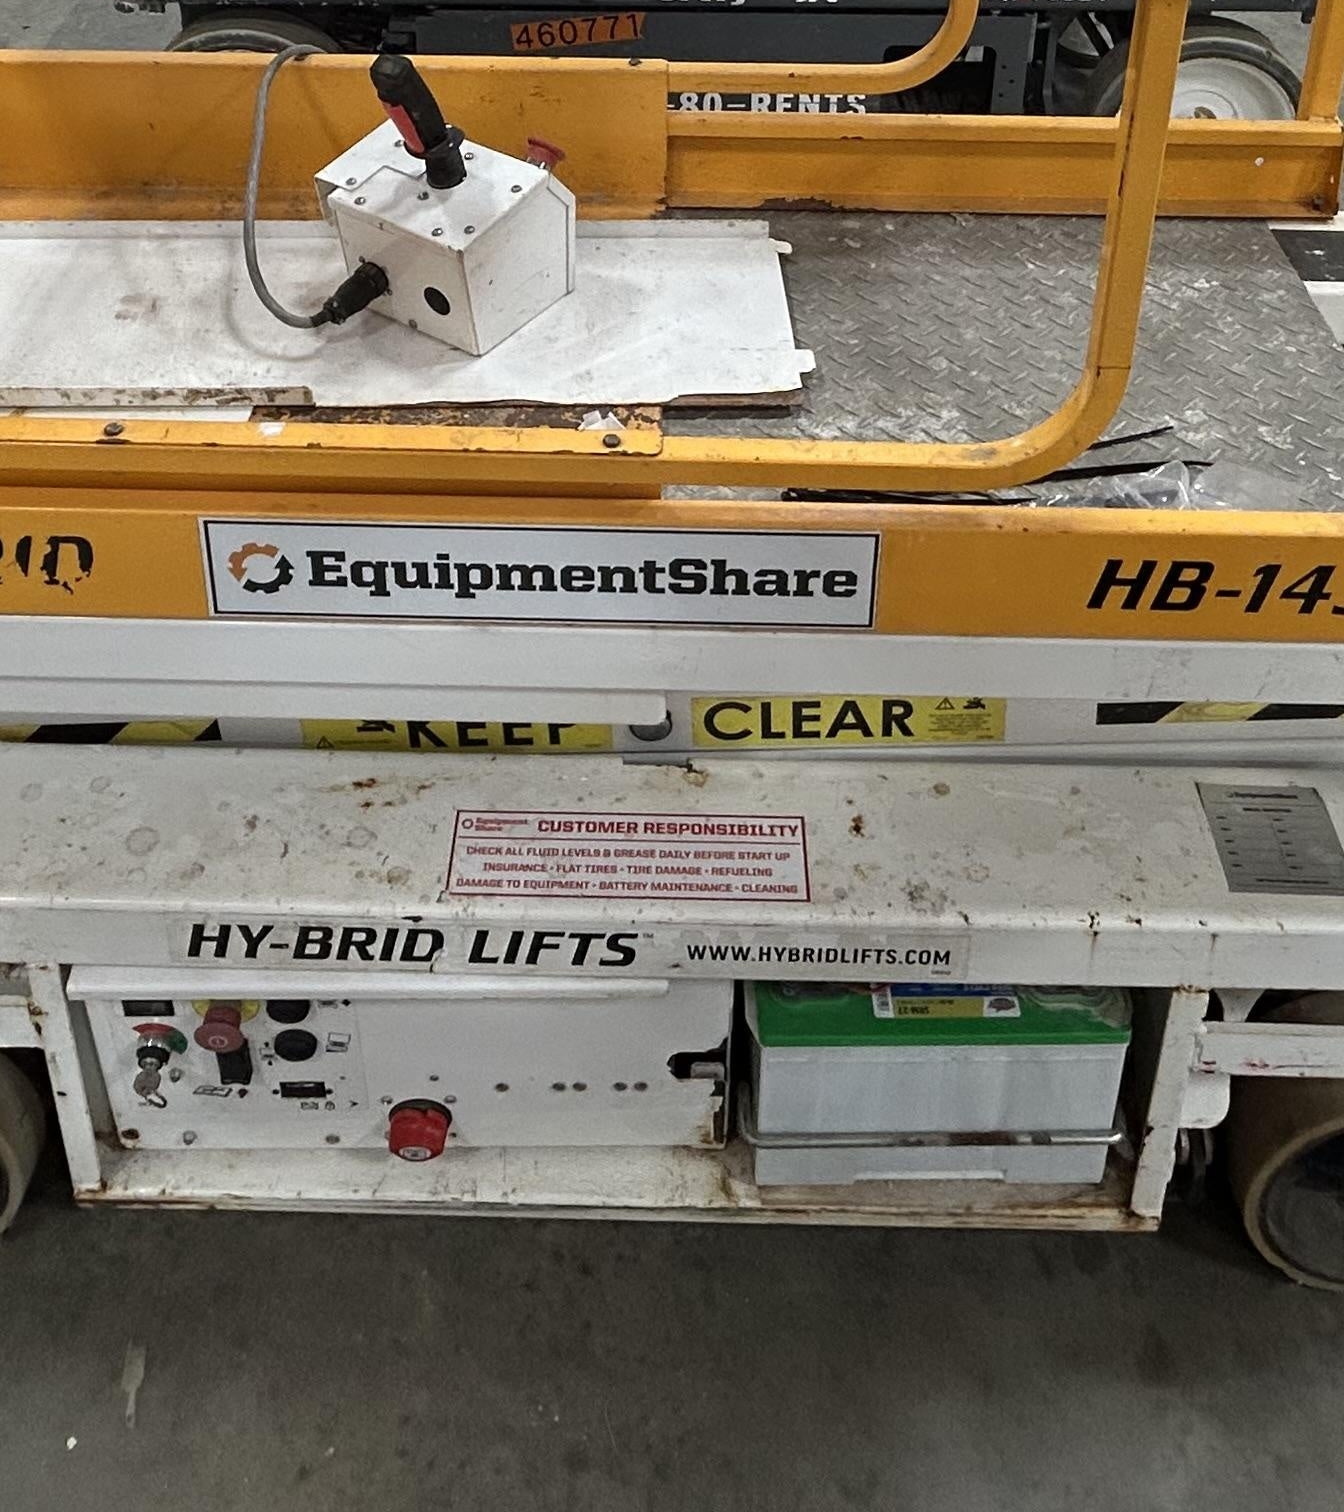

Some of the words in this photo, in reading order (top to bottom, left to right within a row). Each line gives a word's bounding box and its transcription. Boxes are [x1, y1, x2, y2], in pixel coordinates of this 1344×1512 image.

[516, 13, 640, 47] 460771
[305, 550, 858, 599] EquipmentShare
[703, 699, 915, 740] CLEAR
[537, 819, 638, 834] CUSTOMER
[643, 821, 799, 838] RESPONSIBILITY
[466, 845, 503, 856] CHECK
[504, 846, 524, 857] ALL
[526, 847, 559, 857] FLUID
[561, 848, 600, 858] LEVELS
[613, 848, 657, 859] GREASE
[658, 849, 691, 859] DAILY
[693, 850, 735, 860] BEFORE
[738, 851, 772, 861] START
[775, 852, 791, 861] UP
[483, 862, 547, 873] INSURANCE
[556, 864, 581, 873] FLAT
[584, 864, 617, 874] TIRES
[626, 865, 653, 875] TIRE
[655, 865, 702, 876] DAMAGE
[711, 866, 773, 877] REFUELING
[456, 877, 503, 888] DAMAGE
[506, 879, 521, 889] TO
[523, 879, 590, 890] EQUIPMENT
[599, 881, 648, 891] BATTERY
[650, 882, 736, 893] MAINTENANCE
[741, 883, 798, 894] CLEANING
[187, 922, 445, 963] HY-BRID
[468, 929, 640, 967] LIFTS
[687, 944, 951, 966] WWW.HYBRIDLIFTS.COM
